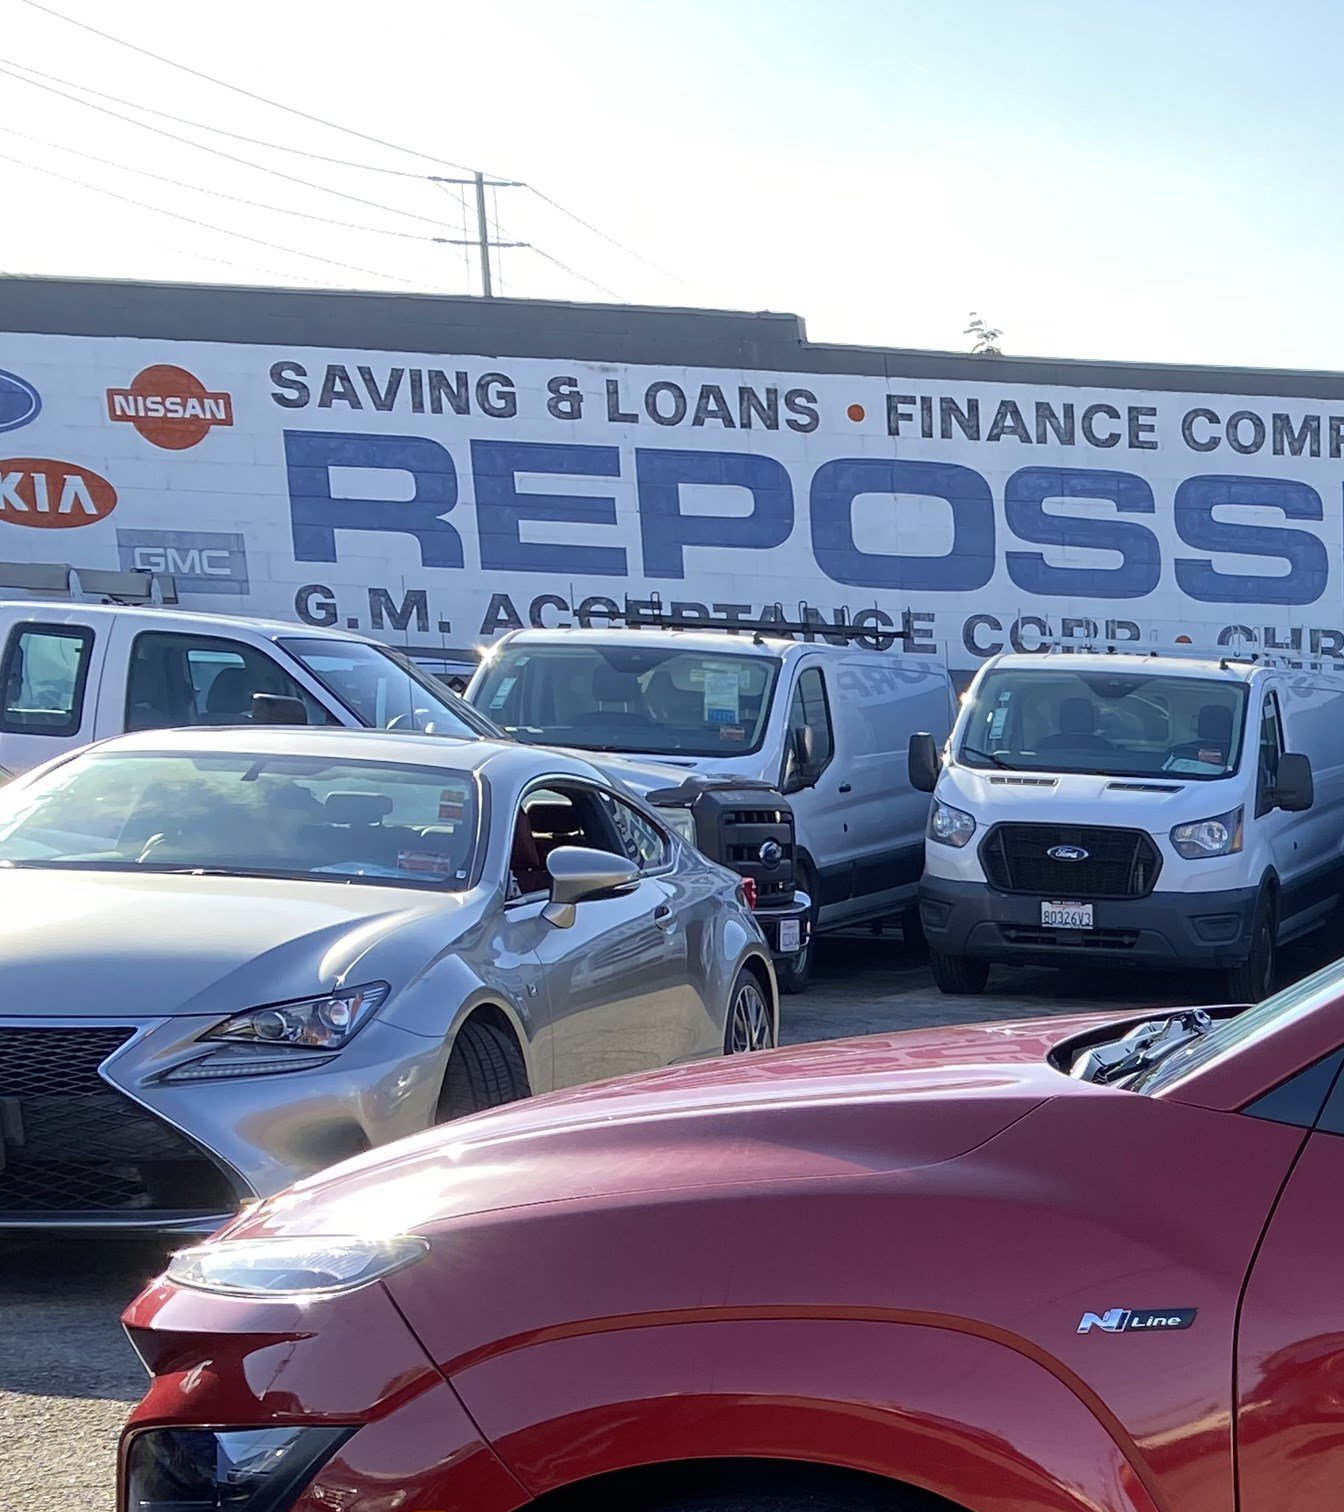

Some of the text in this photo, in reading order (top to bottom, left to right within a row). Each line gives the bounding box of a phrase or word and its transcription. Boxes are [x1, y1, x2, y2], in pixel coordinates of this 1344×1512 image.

[113, 394, 226, 420] NISSAN
[270, 361, 517, 419] SAVING
[547, 377, 584, 421] &
[607, 379, 820, 434] LOANS
[886, 393, 1160, 451] FINANCE
[0, 471, 99, 516] KIA
[134, 546, 232, 576] GMC
[294, 583, 451, 634] G.M.
[1131, 1316, 1182, 1328] Line
